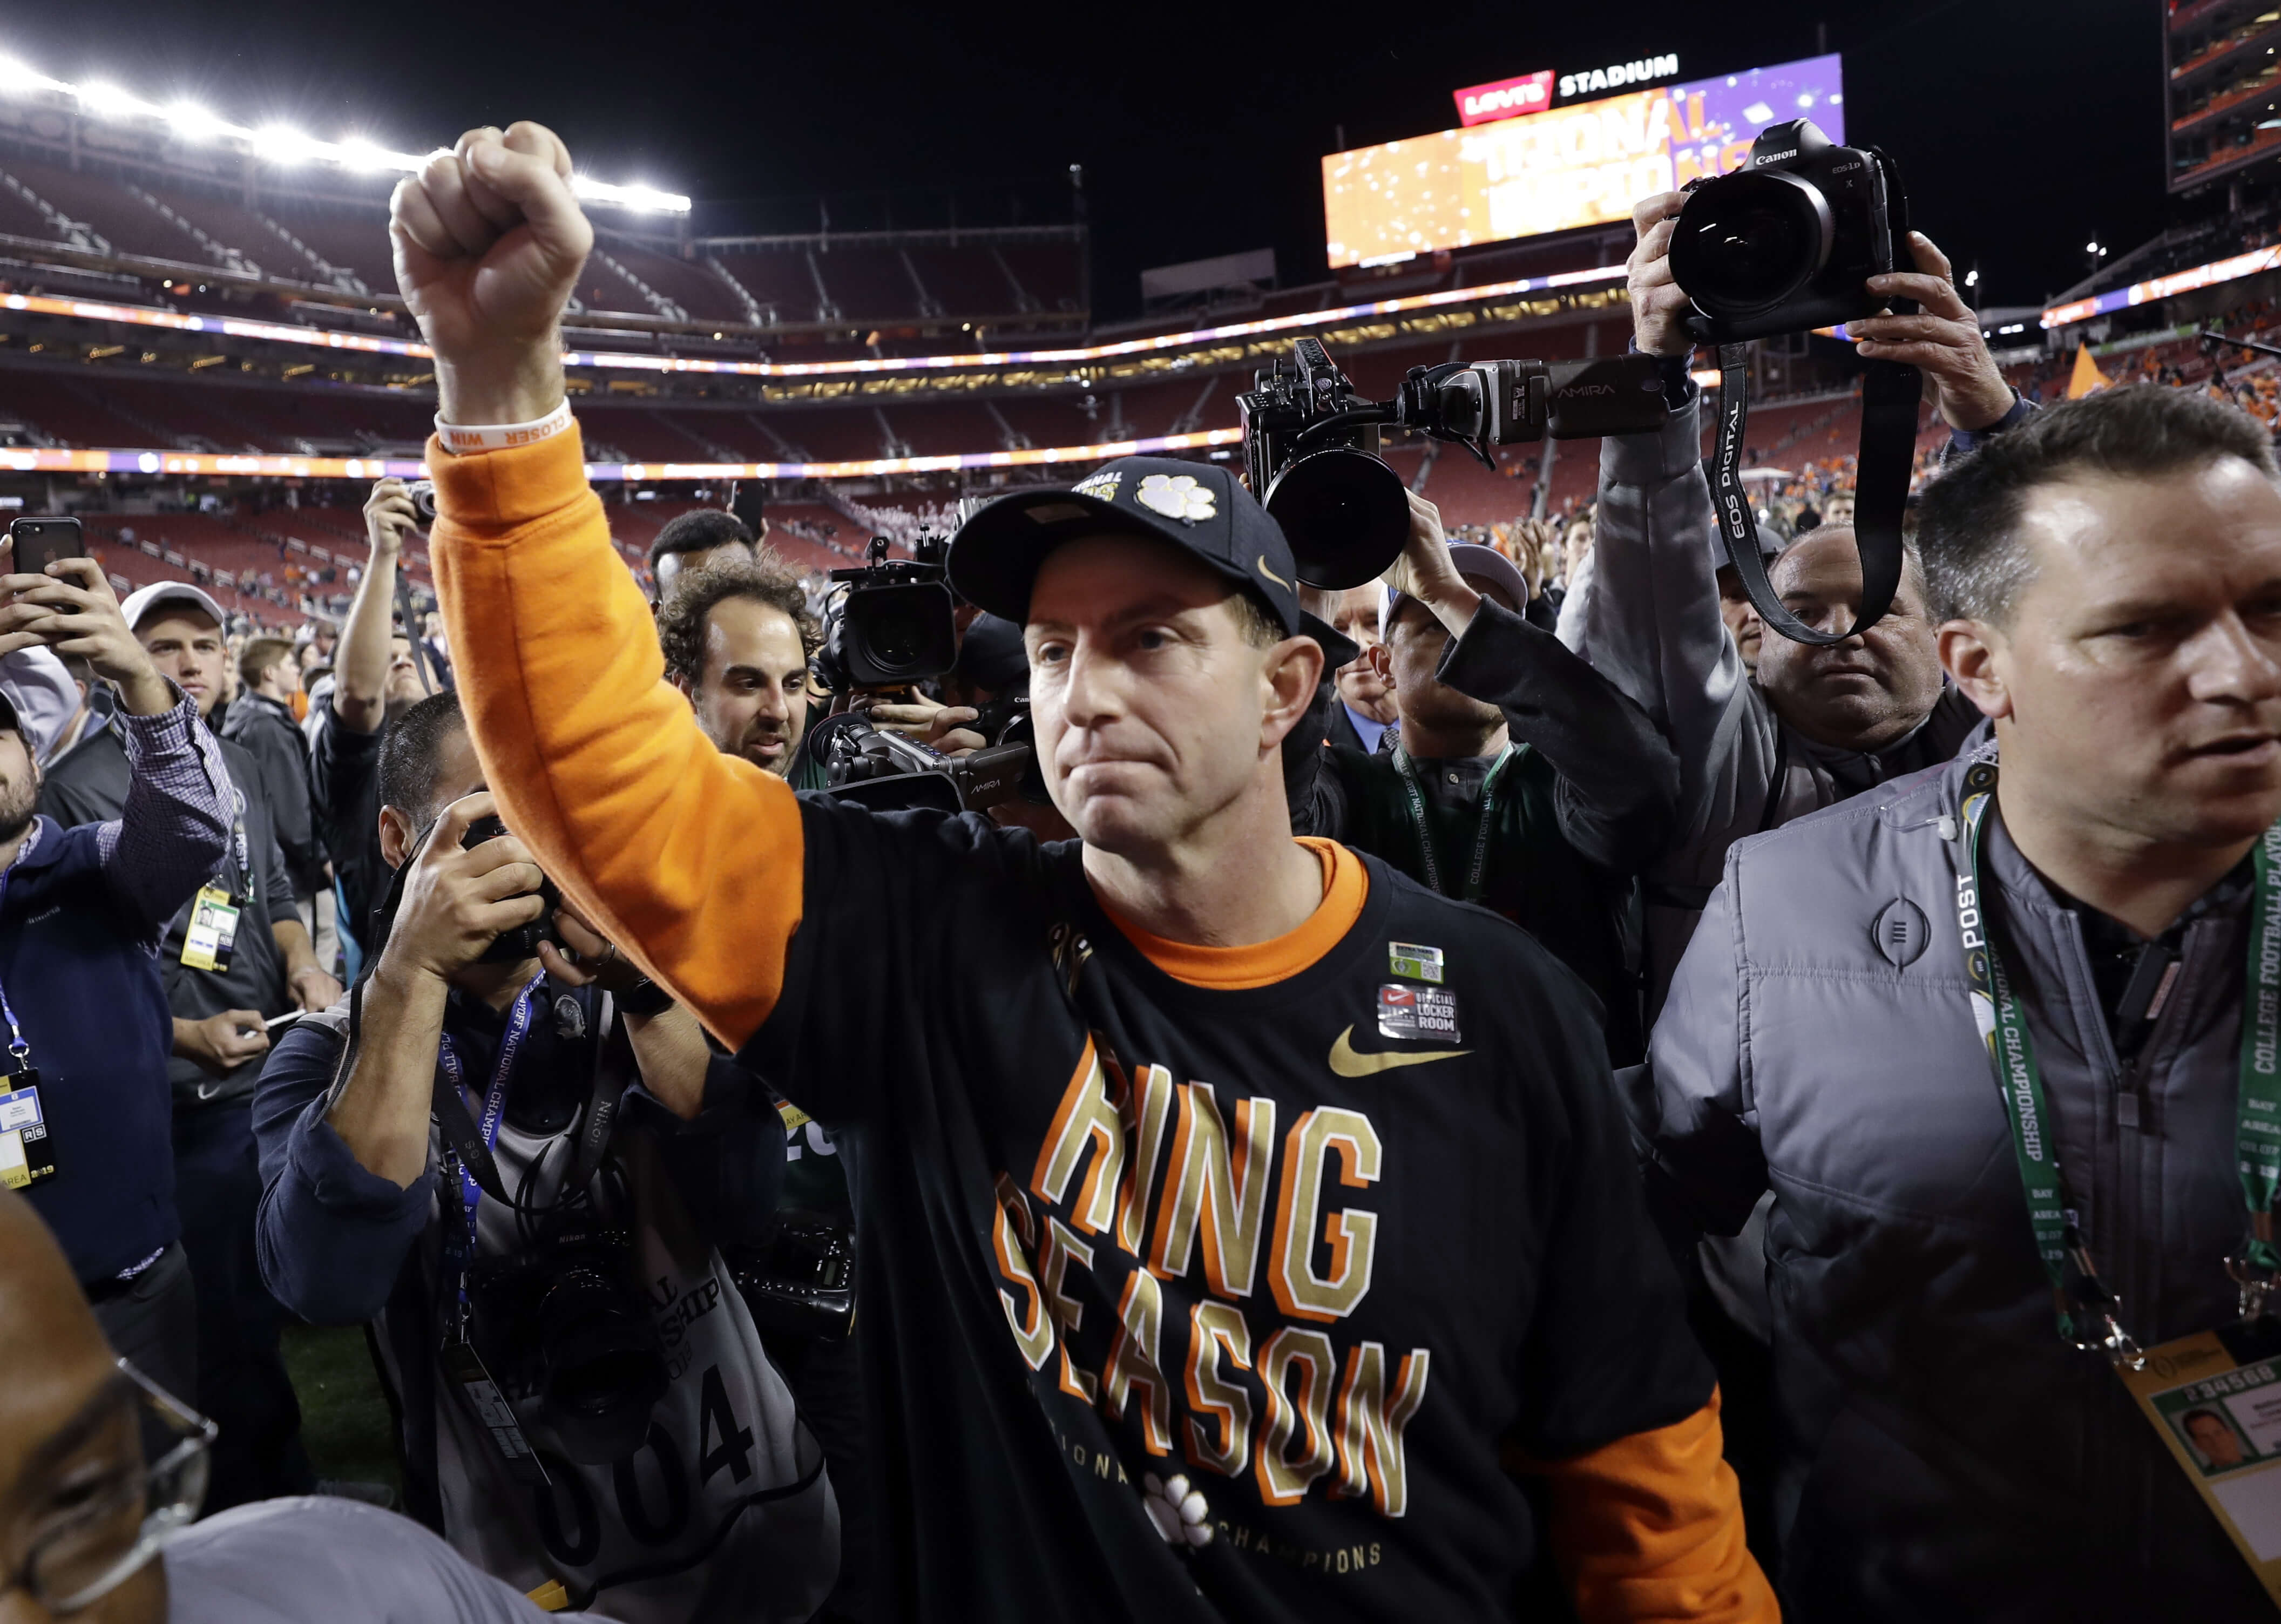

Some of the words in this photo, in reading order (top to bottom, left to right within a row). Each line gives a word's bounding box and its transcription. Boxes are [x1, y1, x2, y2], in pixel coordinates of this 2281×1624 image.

[1559, 53, 1679, 98] STADIUM
[1755, 147, 1797, 166] Canon
[1556, 384, 1616, 398] AMIRA
[450, 431, 484, 446] WIN
[504, 415, 565, 445] CLOSER
[1721, 401, 1739, 489] DIGITAL
[1725, 493, 1745, 539] EOS
[971, 779, 1000, 795] AMIRA
[1422, 840, 1441, 896] CHAMPIONS
[1470, 842, 1485, 885] COLLEGE
[2264, 816, 2281, 888] PLAYO
[1957, 874, 1986, 950] POST
[2259, 891, 2281, 987] FOOTBALL
[506, 985, 539, 1028] PLAYOFF
[1416, 1003, 1454, 1019] LOCKER
[1418, 1016, 1455, 1032] ROOM
[2254, 988, 2280, 1075] COLLEGE
[491, 1029, 520, 1090] NATIONAL
[480, 1089, 504, 1148] CHAMPI
[2002, 1025, 2043, 1162] CHAMPIONSHIP
[1030, 1028, 1382, 1323] RING
[558, 1233, 586, 1244] Nikon
[992, 1170, 1431, 1520] SEASON
[1217, 1519, 1383, 1574] CHAPIONS
